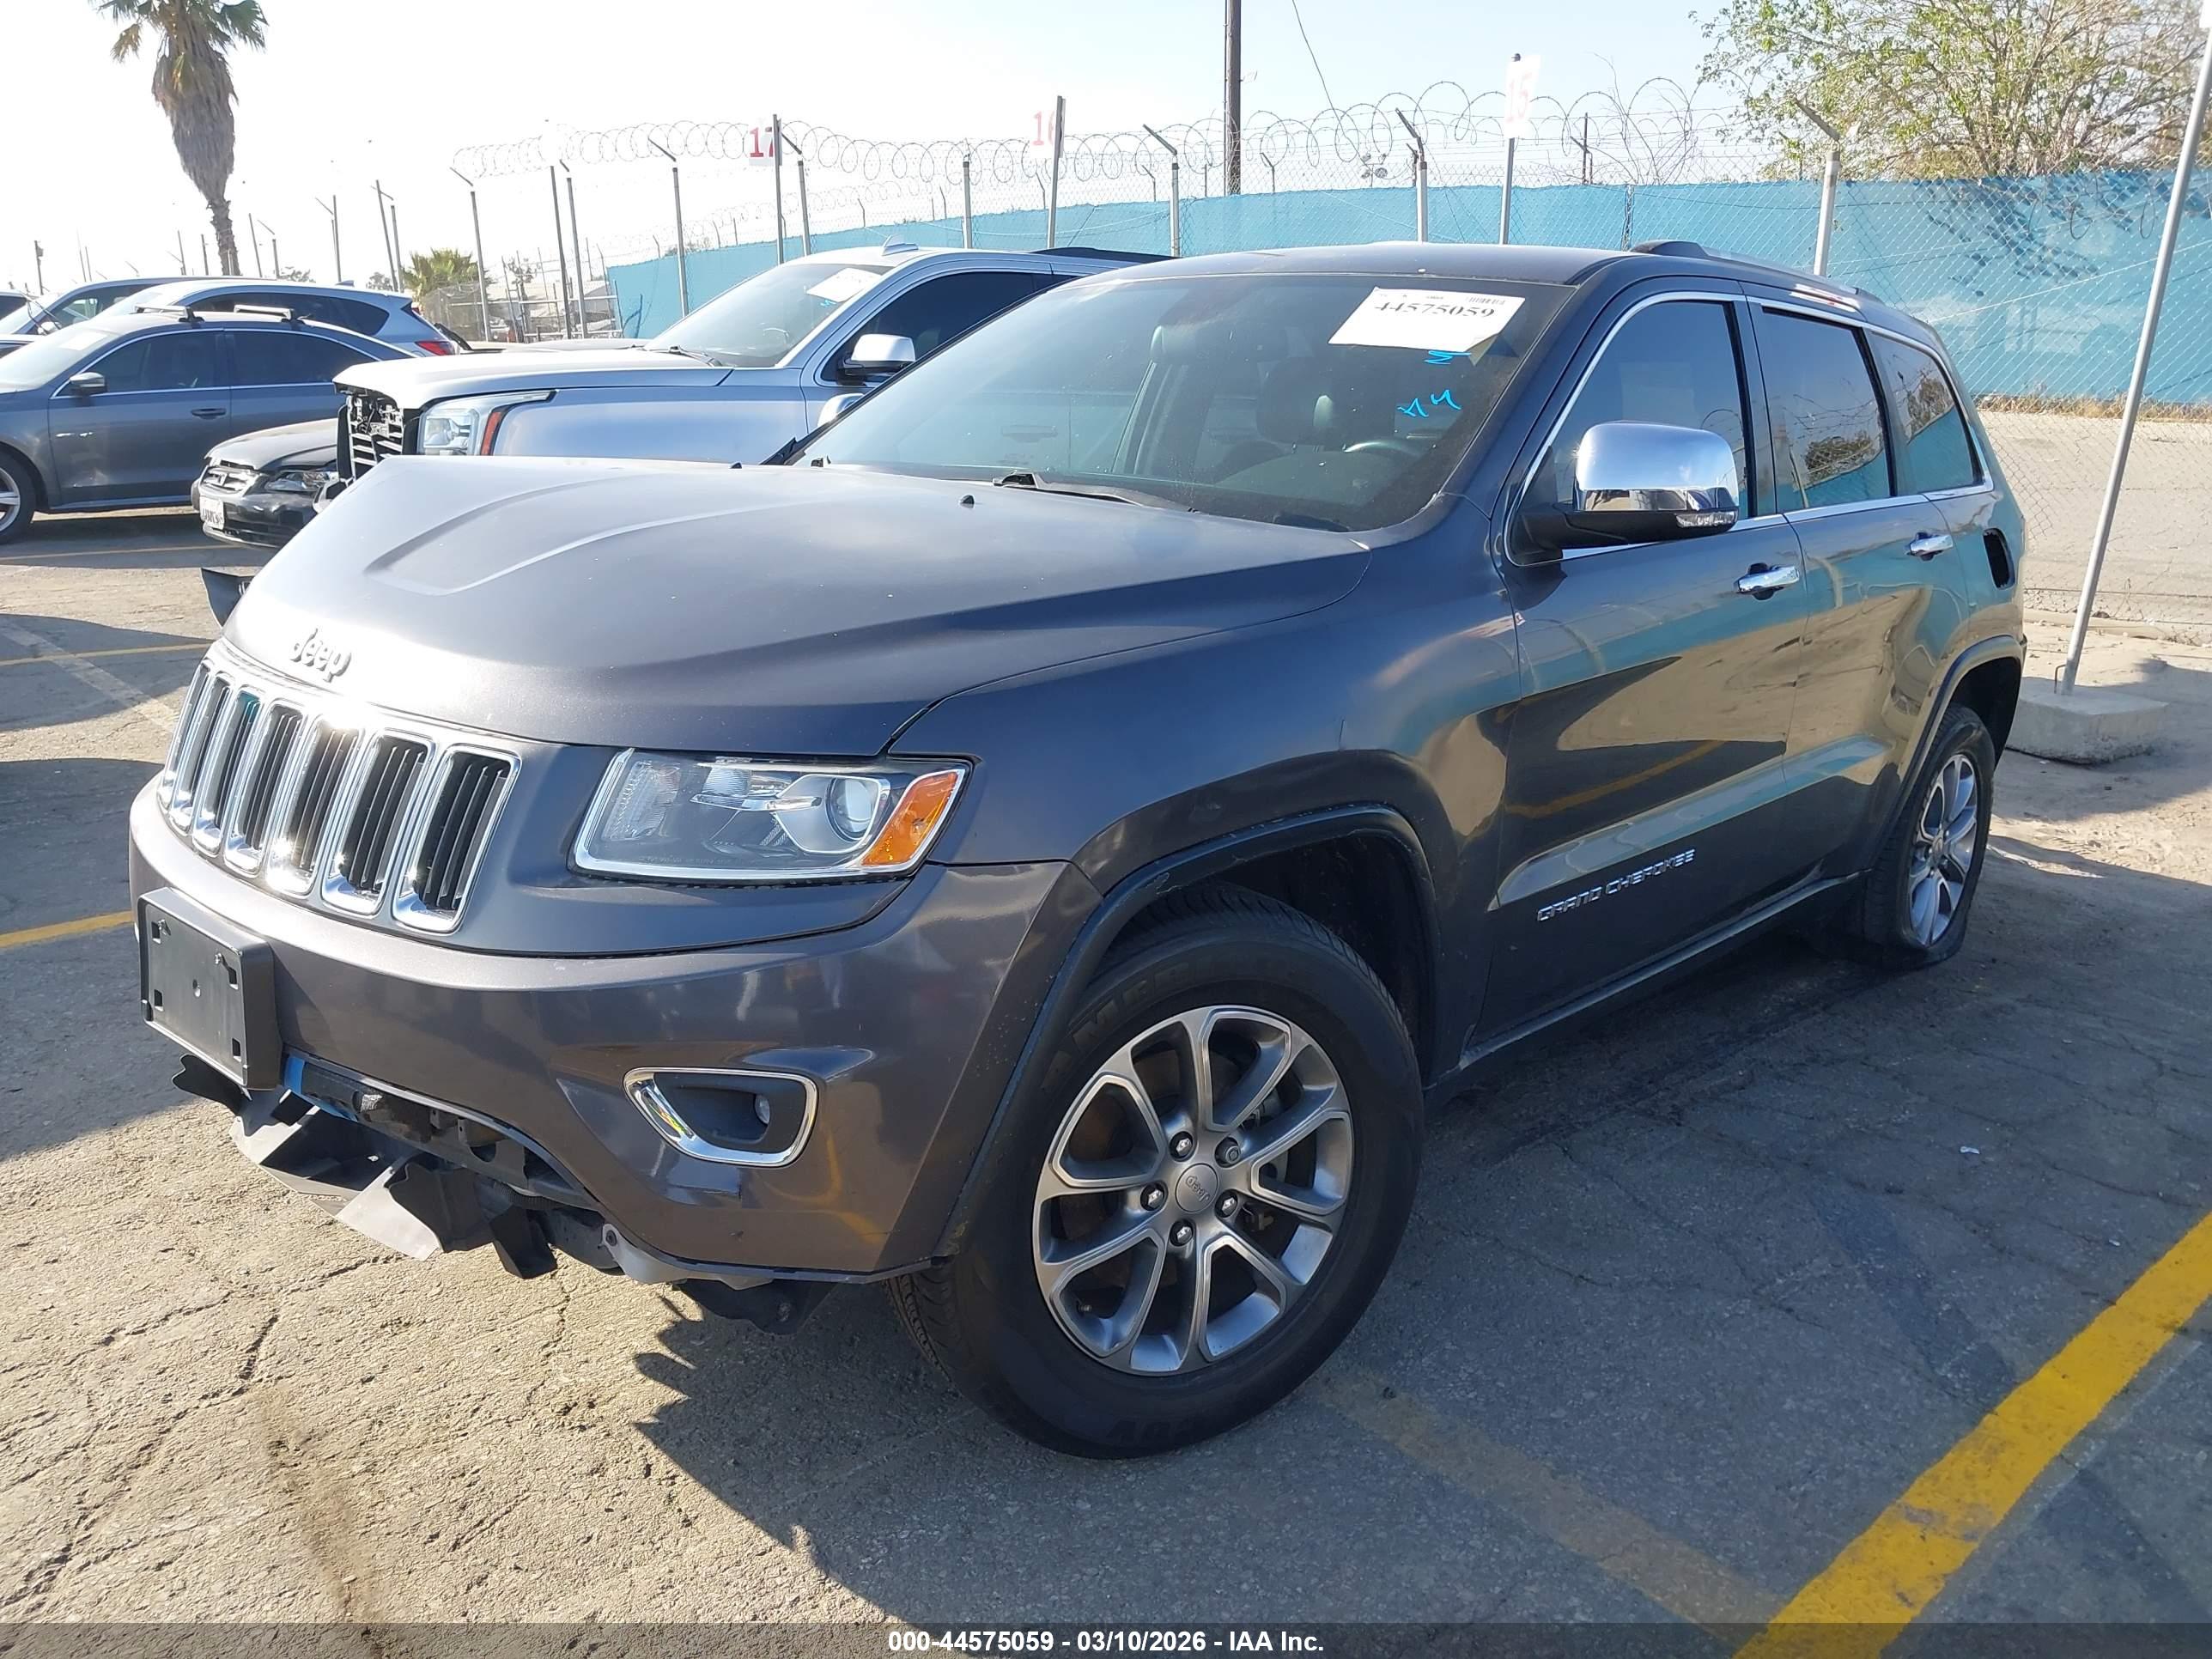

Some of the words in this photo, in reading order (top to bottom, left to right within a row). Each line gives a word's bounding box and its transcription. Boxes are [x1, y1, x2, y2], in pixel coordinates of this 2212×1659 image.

[291, 626, 352, 684] Jeep
[1537, 886, 1602, 922] GRAND
[1605, 848, 1696, 895] CHEROKEE
[1185, 1175, 1210, 1203] Jeep
